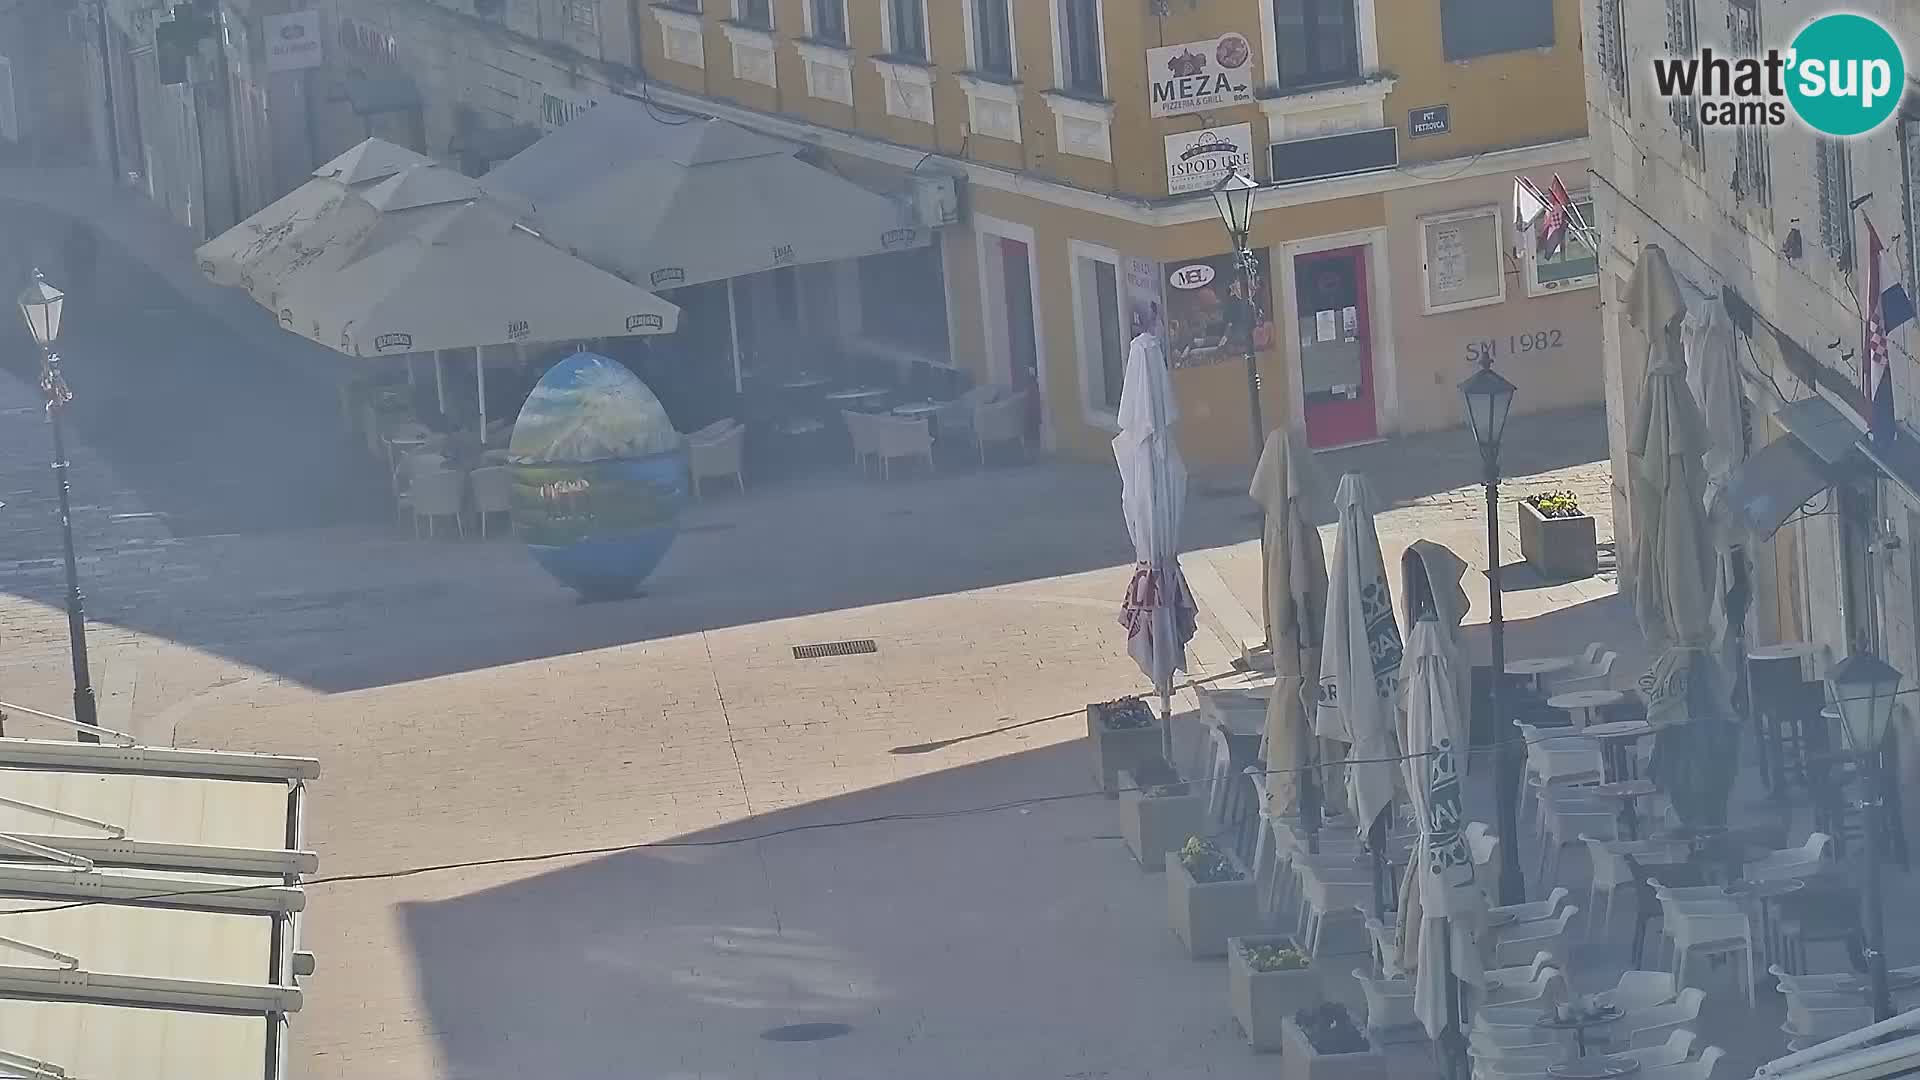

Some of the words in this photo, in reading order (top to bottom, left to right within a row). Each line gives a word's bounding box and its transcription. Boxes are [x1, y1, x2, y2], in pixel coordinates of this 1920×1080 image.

[1152, 72, 1232, 103] MEZA
[1162, 98, 1195, 111] PIZZERIA
[1202, 94, 1224, 105] GRILL
[1171, 158, 1217, 177] ISPOD
[1465, 339, 1497, 362] SM
[1510, 329, 1564, 354] 1982
